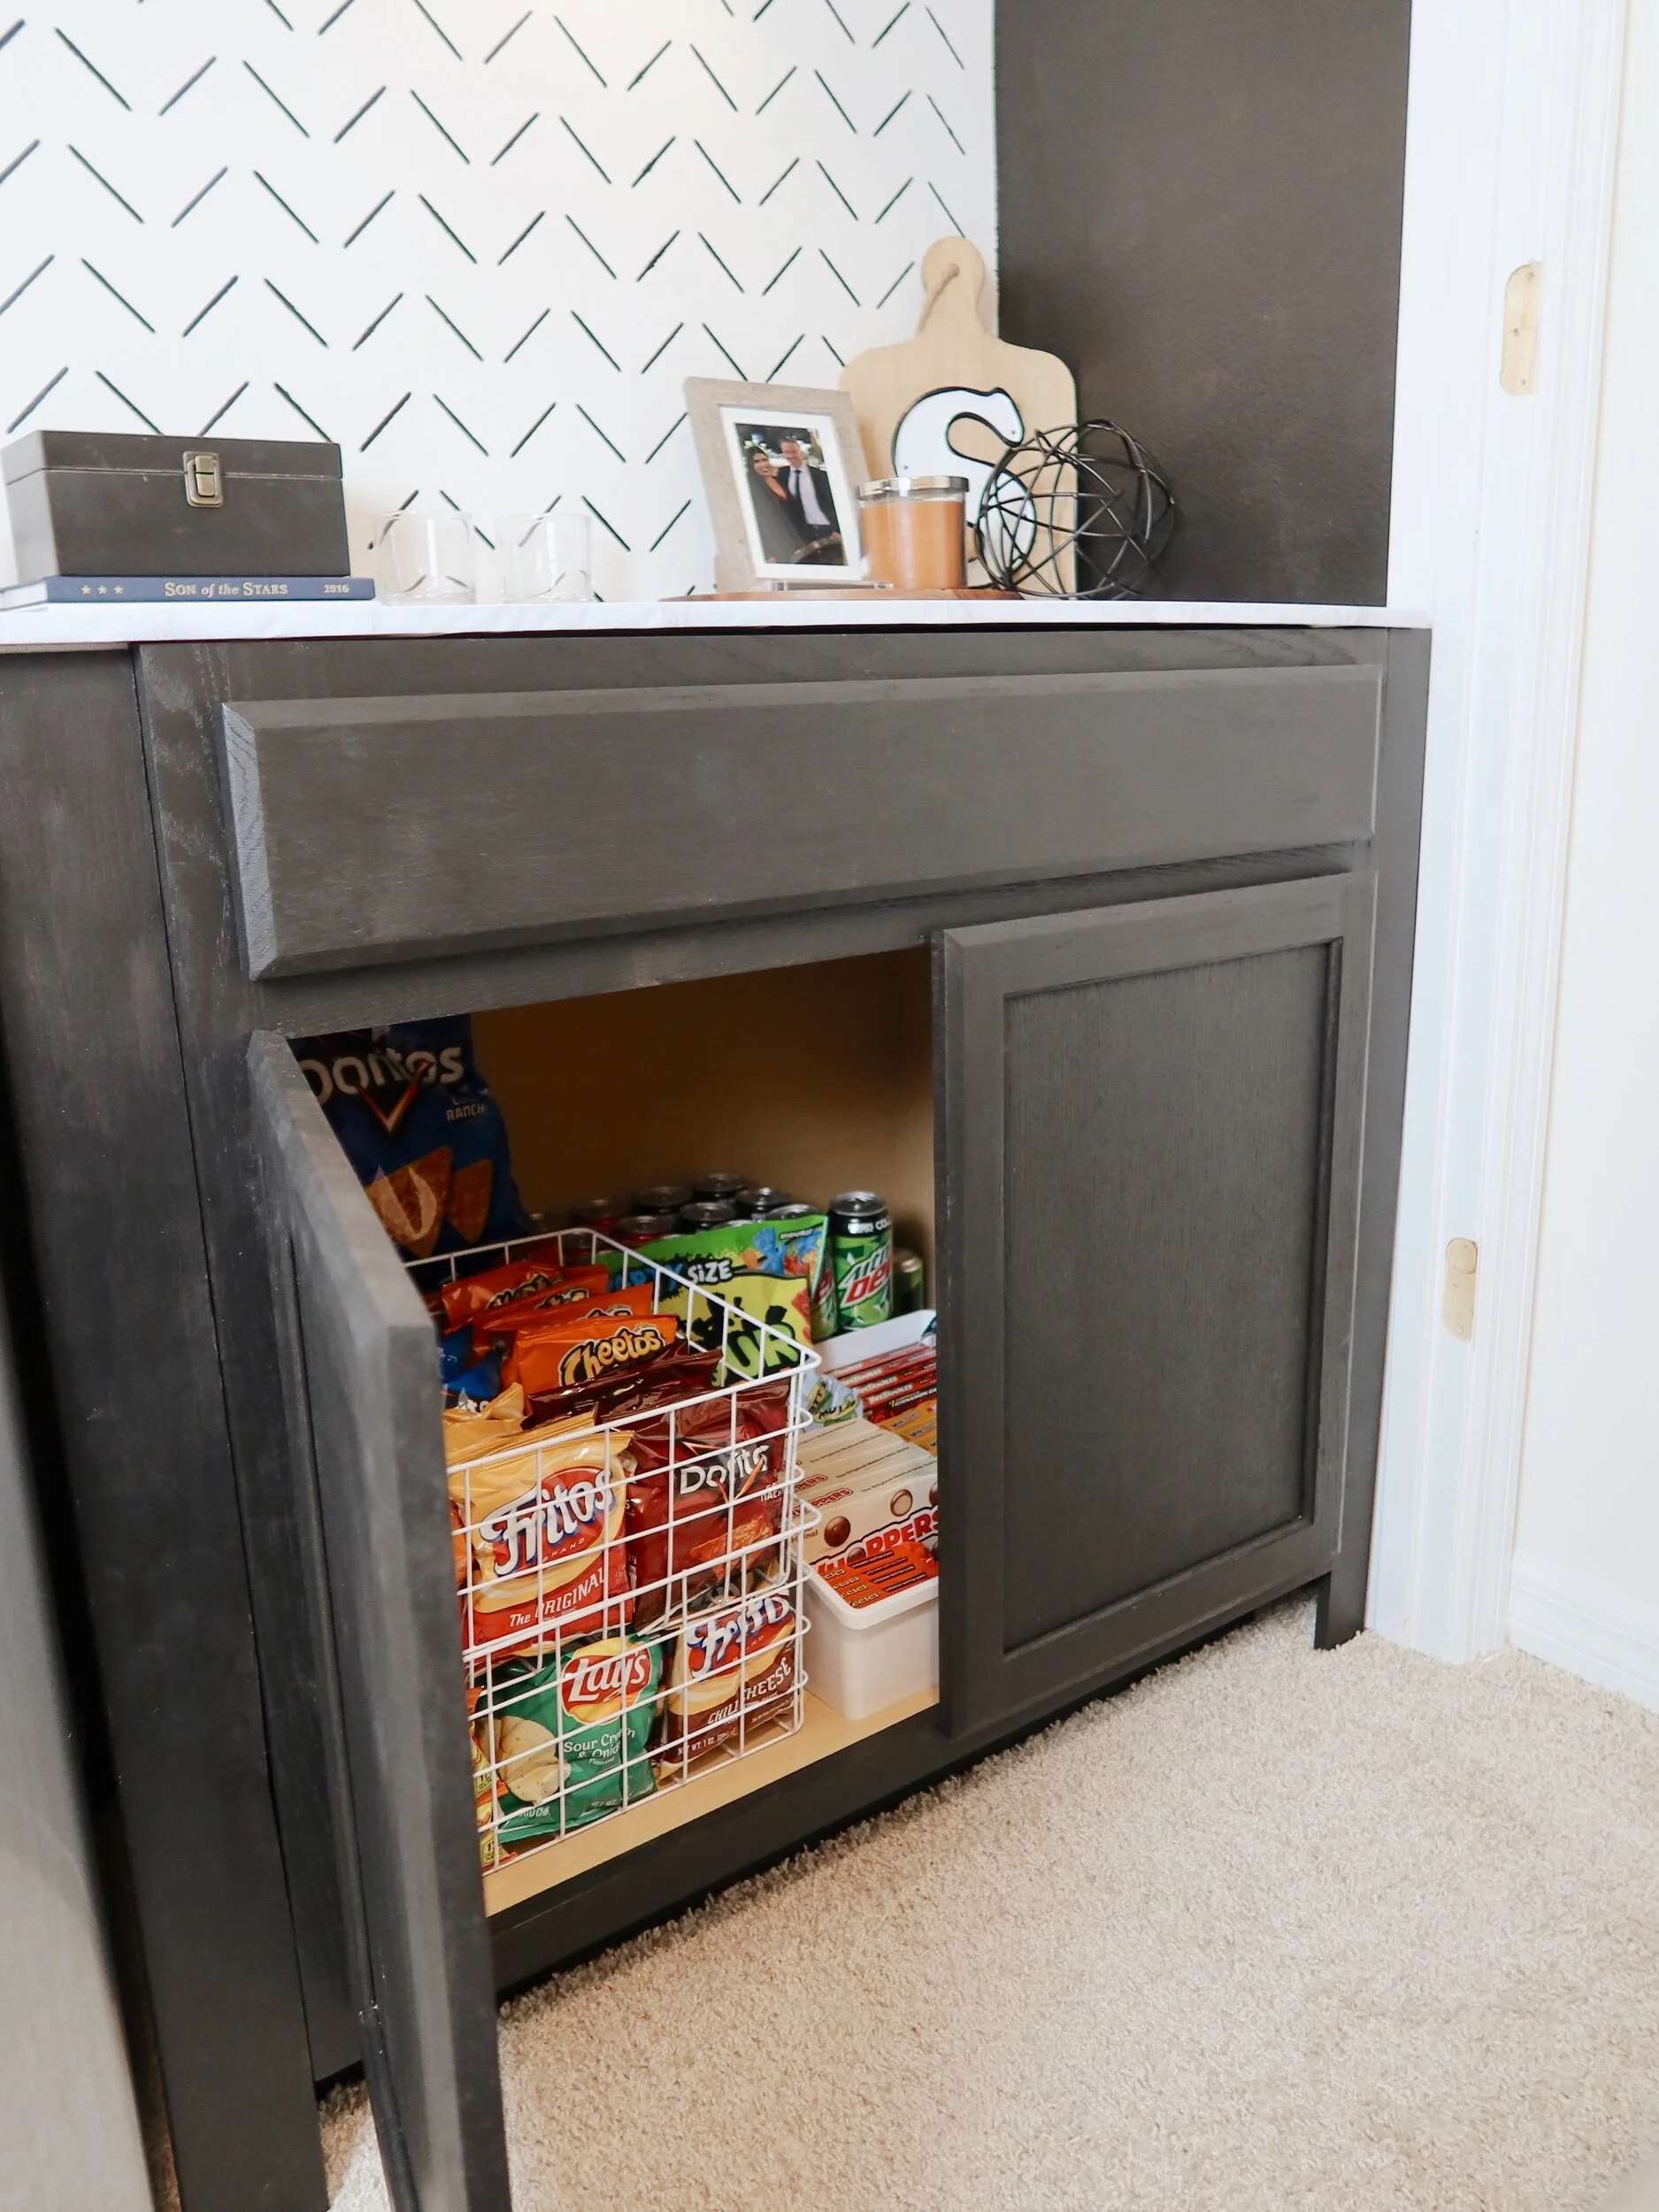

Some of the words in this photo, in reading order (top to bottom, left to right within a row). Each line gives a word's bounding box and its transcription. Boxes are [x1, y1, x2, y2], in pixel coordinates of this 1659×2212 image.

[164, 581, 196, 597] SON
[201, 583, 215, 598] of
[218, 583, 239, 595] the
[242, 581, 288, 596] STARS
[446, 1102, 485, 1122] RANCH
[561, 1329, 664, 1386] Cheetos
[710, 1322, 799, 1386] UR
[479, 1469, 617, 1576] Fritos
[509, 1611, 531, 1628] The
[742, 1656, 792, 1701] HEESE
[563, 1739, 598, 1754] Sour
[600, 1727, 636, 1747] Crem
